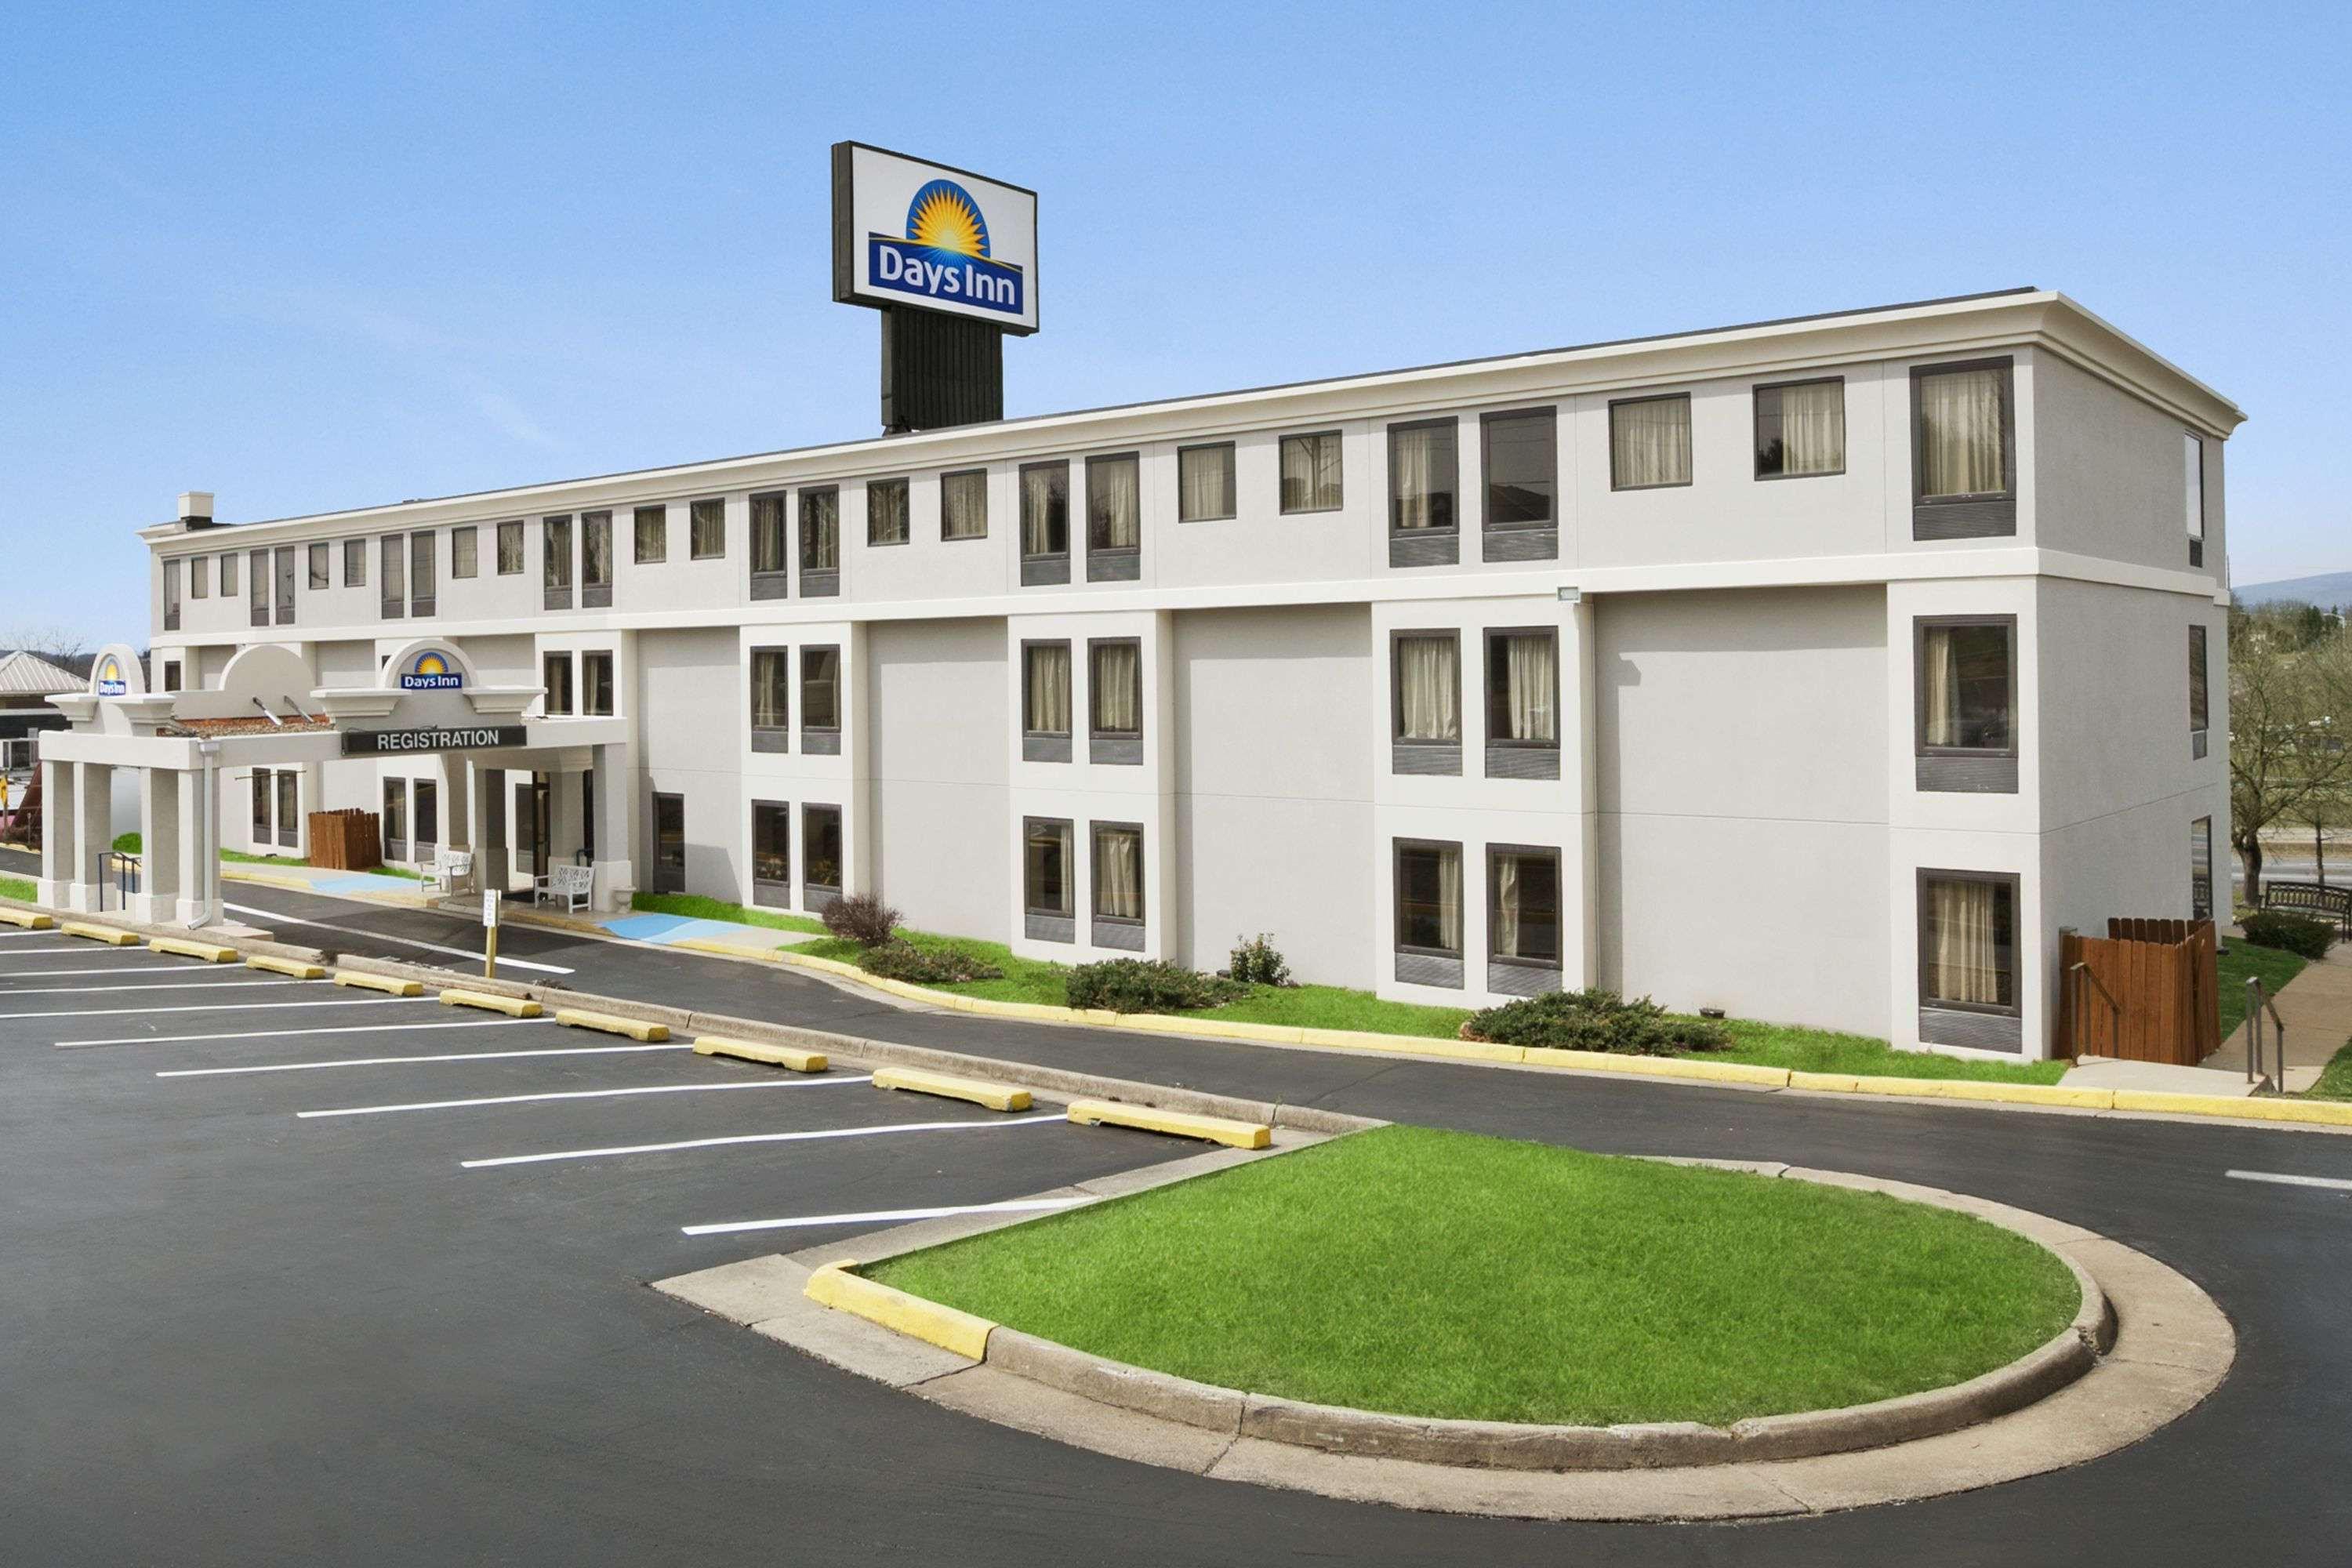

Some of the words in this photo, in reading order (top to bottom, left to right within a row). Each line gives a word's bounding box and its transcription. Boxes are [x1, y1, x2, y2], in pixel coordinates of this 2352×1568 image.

[880, 245, 960, 294] Days
[966, 264, 1014, 305] Inn
[405, 676, 436, 689] Days
[437, 675, 459, 686] Inn
[377, 730, 499, 750] REGISTRATION
